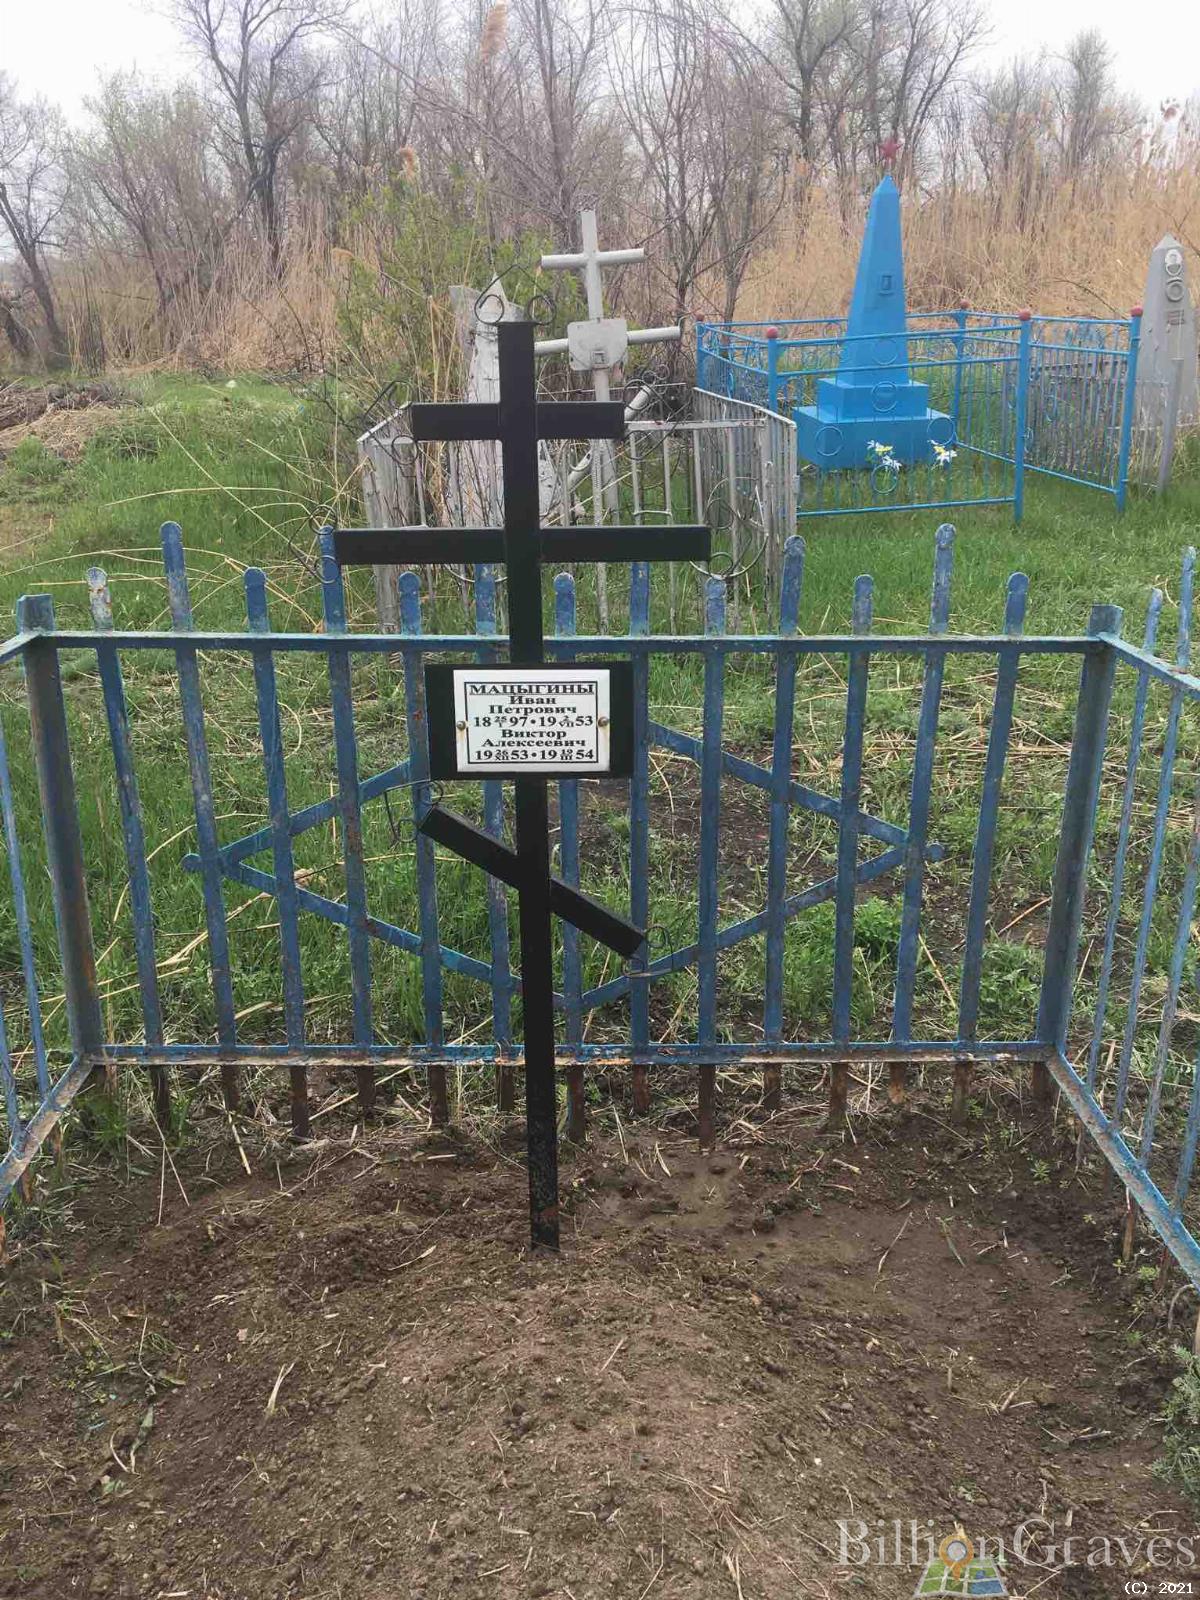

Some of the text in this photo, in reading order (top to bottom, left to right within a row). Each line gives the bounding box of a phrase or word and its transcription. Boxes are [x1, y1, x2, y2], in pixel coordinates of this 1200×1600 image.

[470, 684, 594, 694] МАЦЫГИНЫ
[509, 696, 556, 704] Иван
[488, 705, 576, 715] Петрович
[474, 717, 491, 727] 18
[510, 716, 528, 726] 97
[540, 716, 556, 726] 19
[576, 716, 593, 726] 53
[502, 730, 566, 739] Виктор
[476, 750, 492, 760] 19
[511, 751, 528, 760] 53
[540, 750, 556, 760] 19
[576, 750, 593, 759] 54
